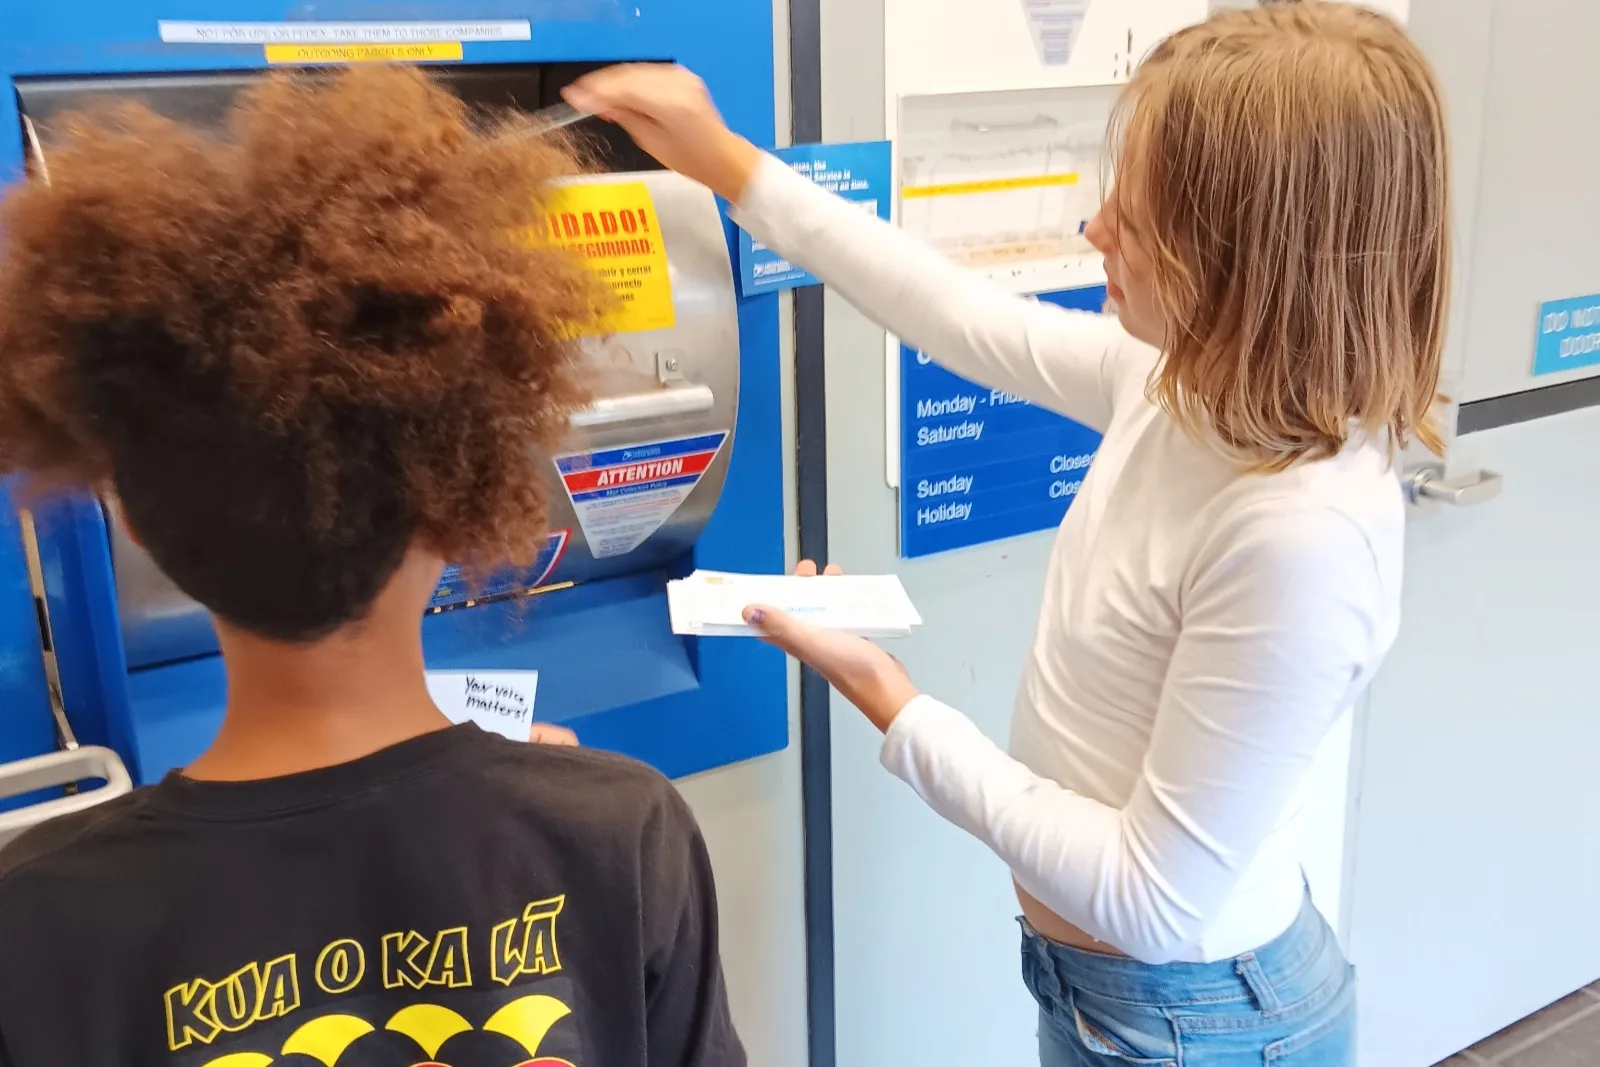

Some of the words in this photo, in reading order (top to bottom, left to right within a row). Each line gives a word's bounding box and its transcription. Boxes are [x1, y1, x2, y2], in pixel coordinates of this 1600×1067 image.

[195, 27, 219, 40] NOT
[222, 26, 246, 40] FOR
[273, 27, 290, 39] OR
[333, 27, 357, 39] TAKE
[363, 26, 391, 39] THEM
[393, 26, 408, 38] TO
[411, 26, 441, 38] THOSE
[445, 24, 502, 38] COMPANIES
[297, 48, 355, 60] OUTGOING
[357, 47, 404, 58] PARCELS
[406, 45, 434, 57] ONLY
[549, 208, 650, 240] IDADO!
[611, 279, 643, 290] orrecto
[916, 394, 977, 419] Monday
[916, 420, 984, 446] Saturday
[597, 458, 684, 487] ATTENTION
[916, 474, 973, 498] Sunday
[916, 502, 972, 526] Holiday
[1049, 479, 1081, 498] Clos
[465, 674, 493, 695] Your
[466, 696, 528, 723] matters!
[164, 953, 301, 1051] KUA
[315, 938, 366, 995] O
[382, 926, 472, 990] KA
